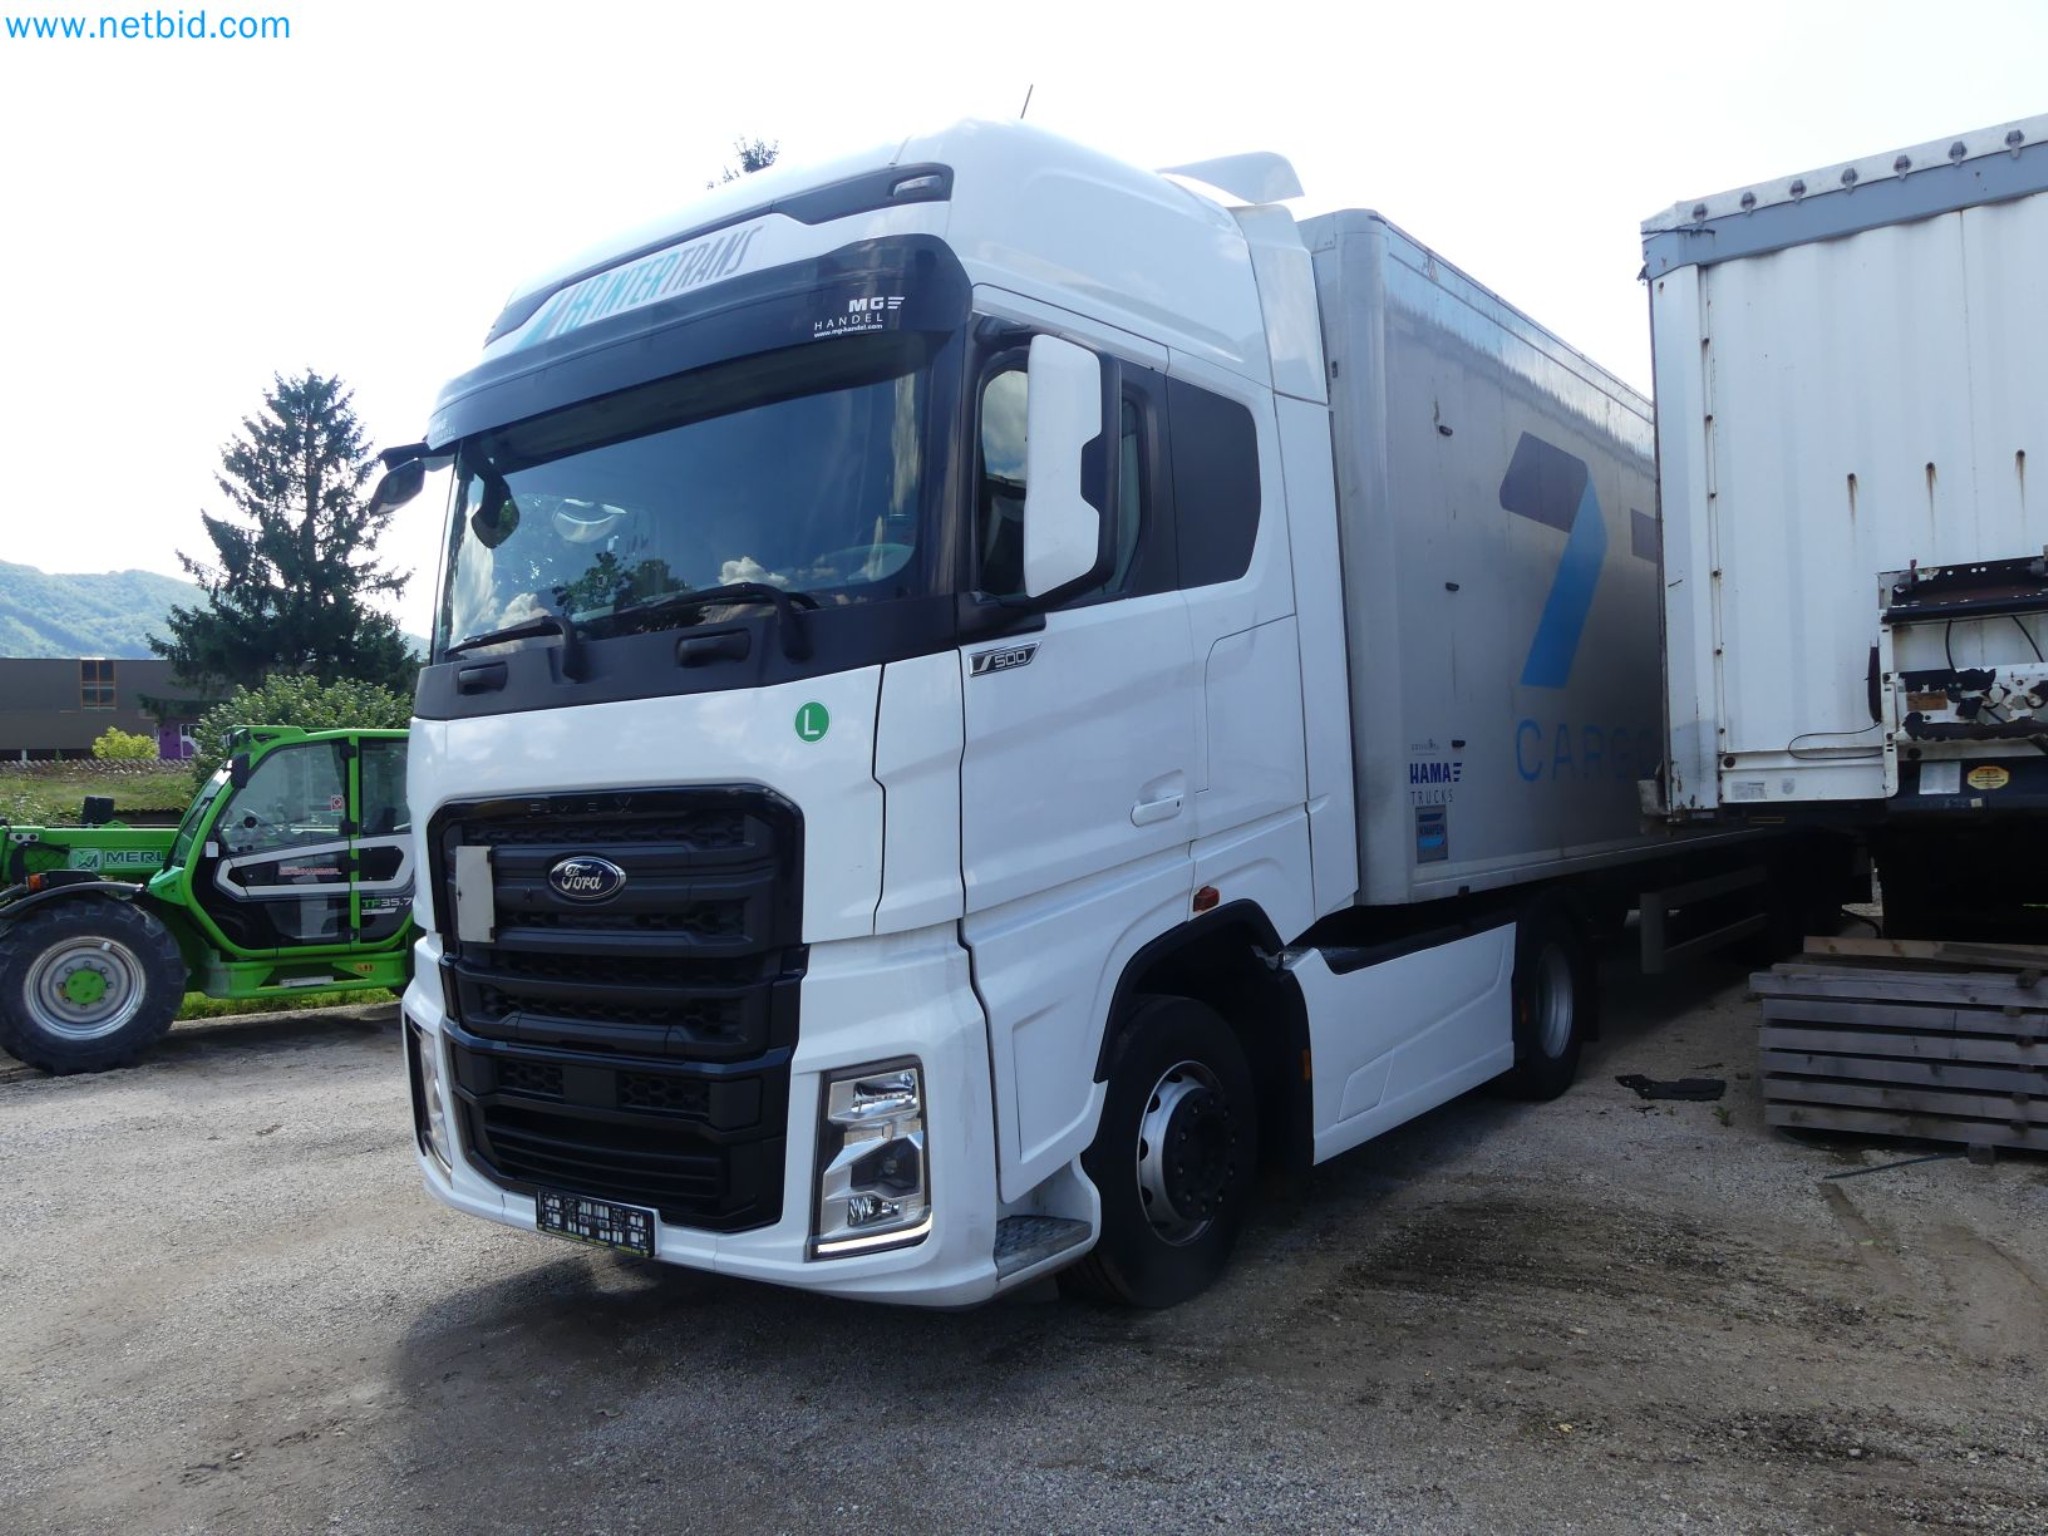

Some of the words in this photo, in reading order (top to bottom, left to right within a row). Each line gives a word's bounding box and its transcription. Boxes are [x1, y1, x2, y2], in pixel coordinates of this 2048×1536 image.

[814, 312, 883, 331] HANDEL
[994, 650, 1027, 668] 500
[804, 708, 820, 735] L
[1410, 788, 1454, 805] TRUCKS
[561, 863, 603, 890] Ford
